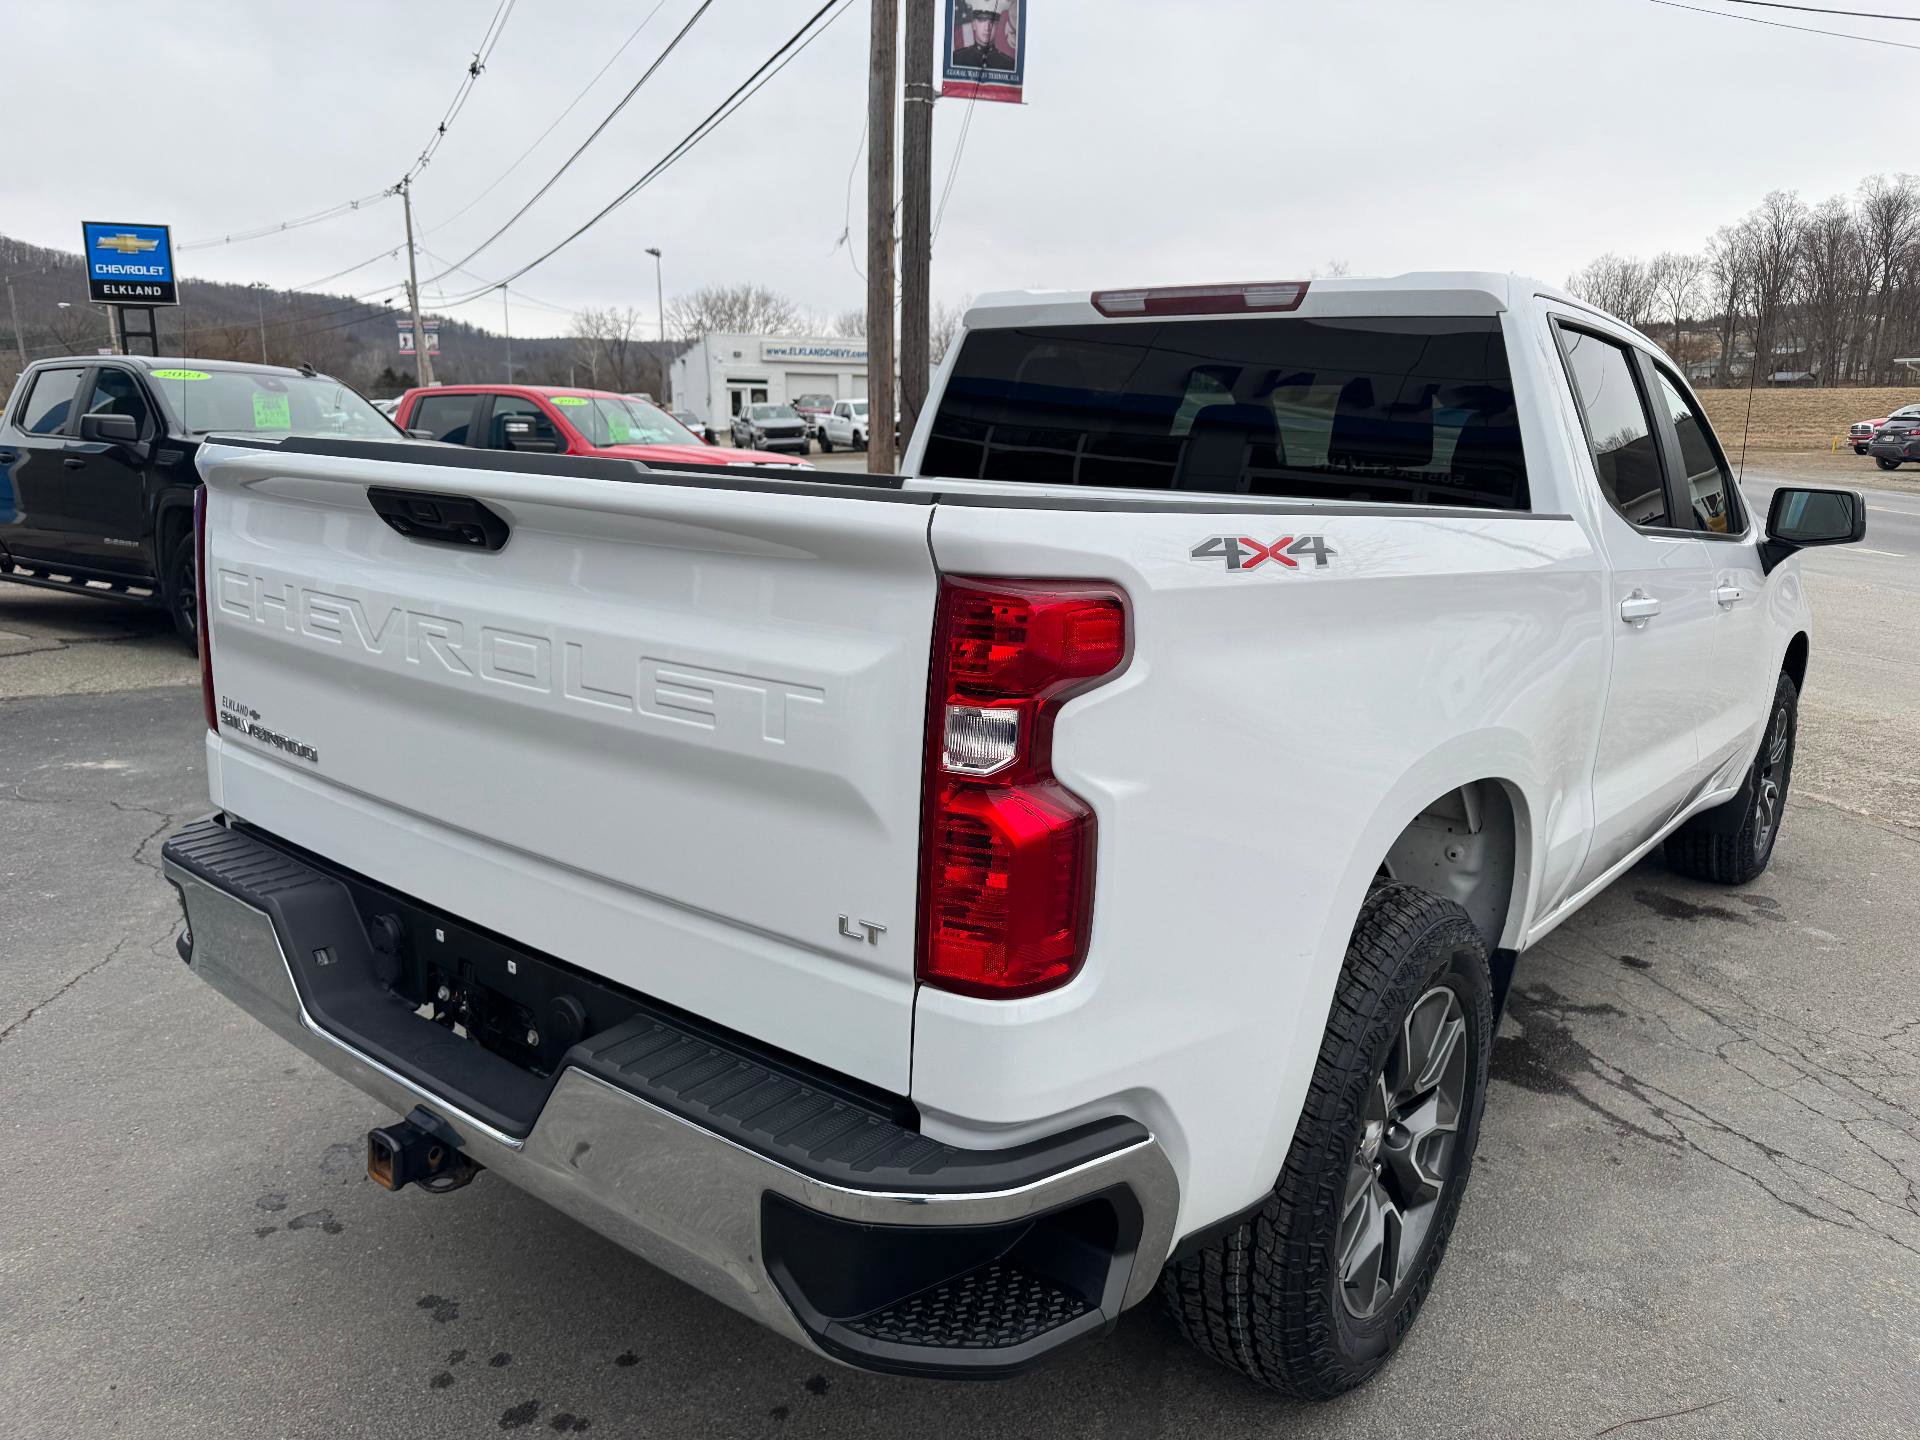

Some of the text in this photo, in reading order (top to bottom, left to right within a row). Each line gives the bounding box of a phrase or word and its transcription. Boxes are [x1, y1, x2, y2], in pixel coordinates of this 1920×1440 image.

[95, 264, 164, 275] CHEVROLET
[103, 284, 161, 296] ELKLAND
[217, 567, 825, 745] CHEVROLET
[222, 695, 249, 717] ELKLAND
[220, 710, 318, 762] SILVERADO
[838, 913, 888, 946] LT
